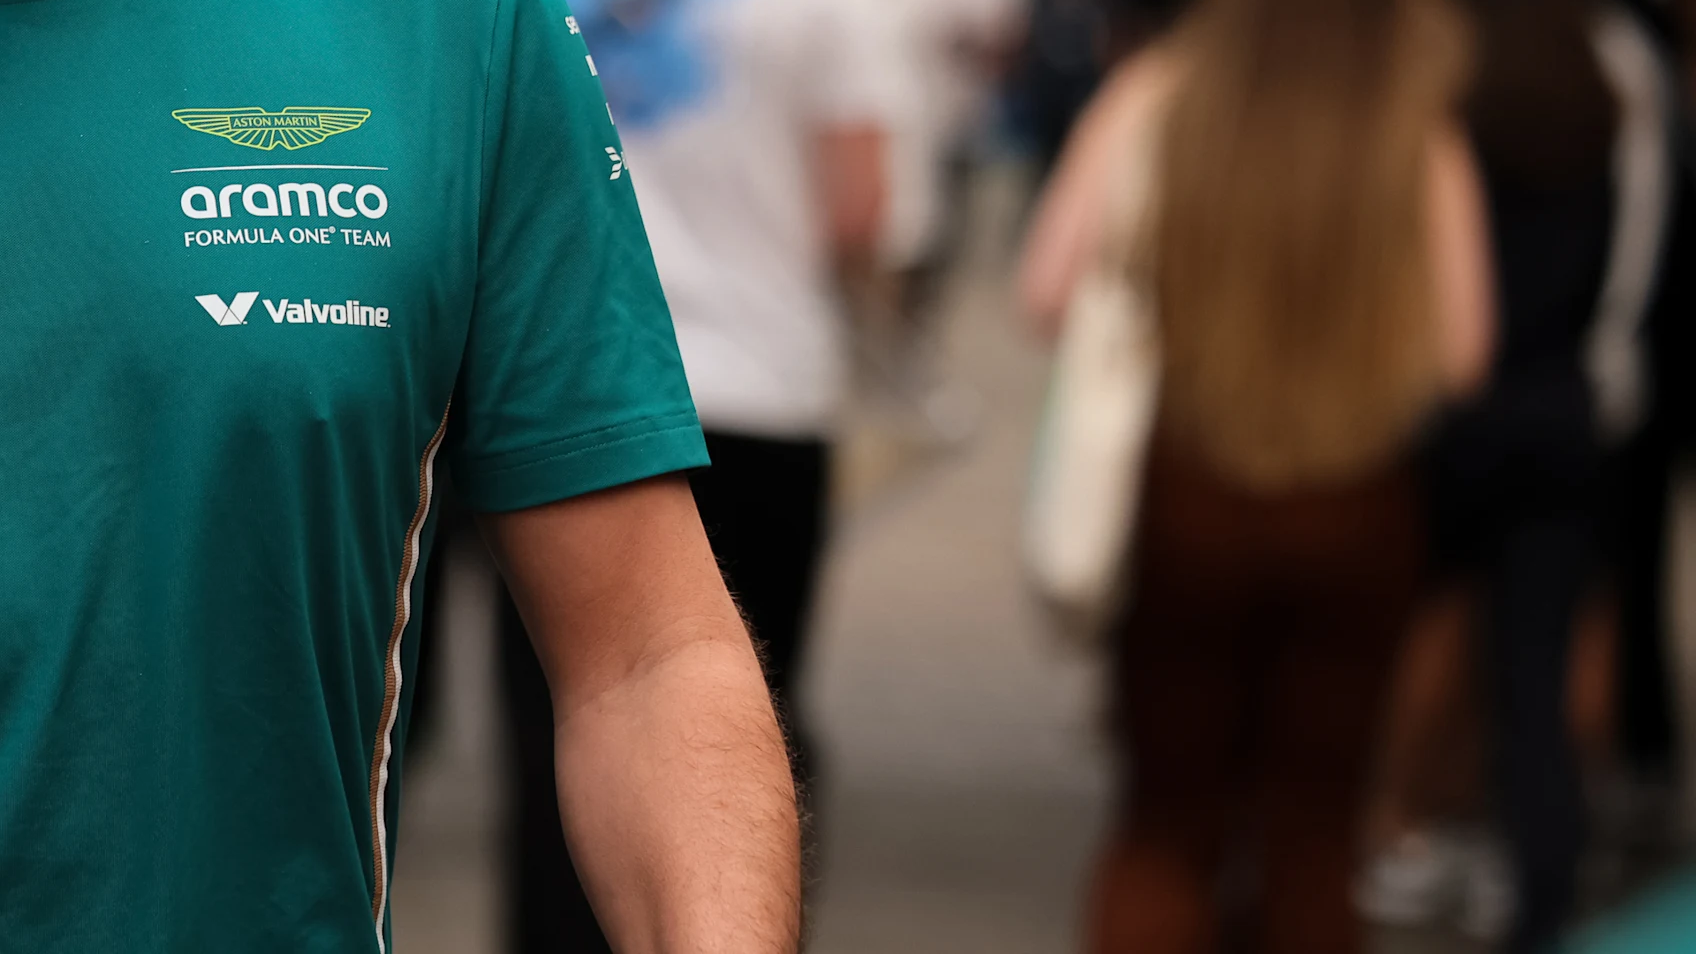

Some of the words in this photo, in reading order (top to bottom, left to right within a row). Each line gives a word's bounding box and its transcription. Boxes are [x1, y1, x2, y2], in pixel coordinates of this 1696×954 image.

[232, 116, 272, 128] ASTON
[273, 116, 318, 127] MARTIN
[180, 182, 388, 219] aramco
[184, 228, 284, 248] FORMULA
[340, 228, 391, 248] TEAM
[262, 298, 390, 328] Valvoline
